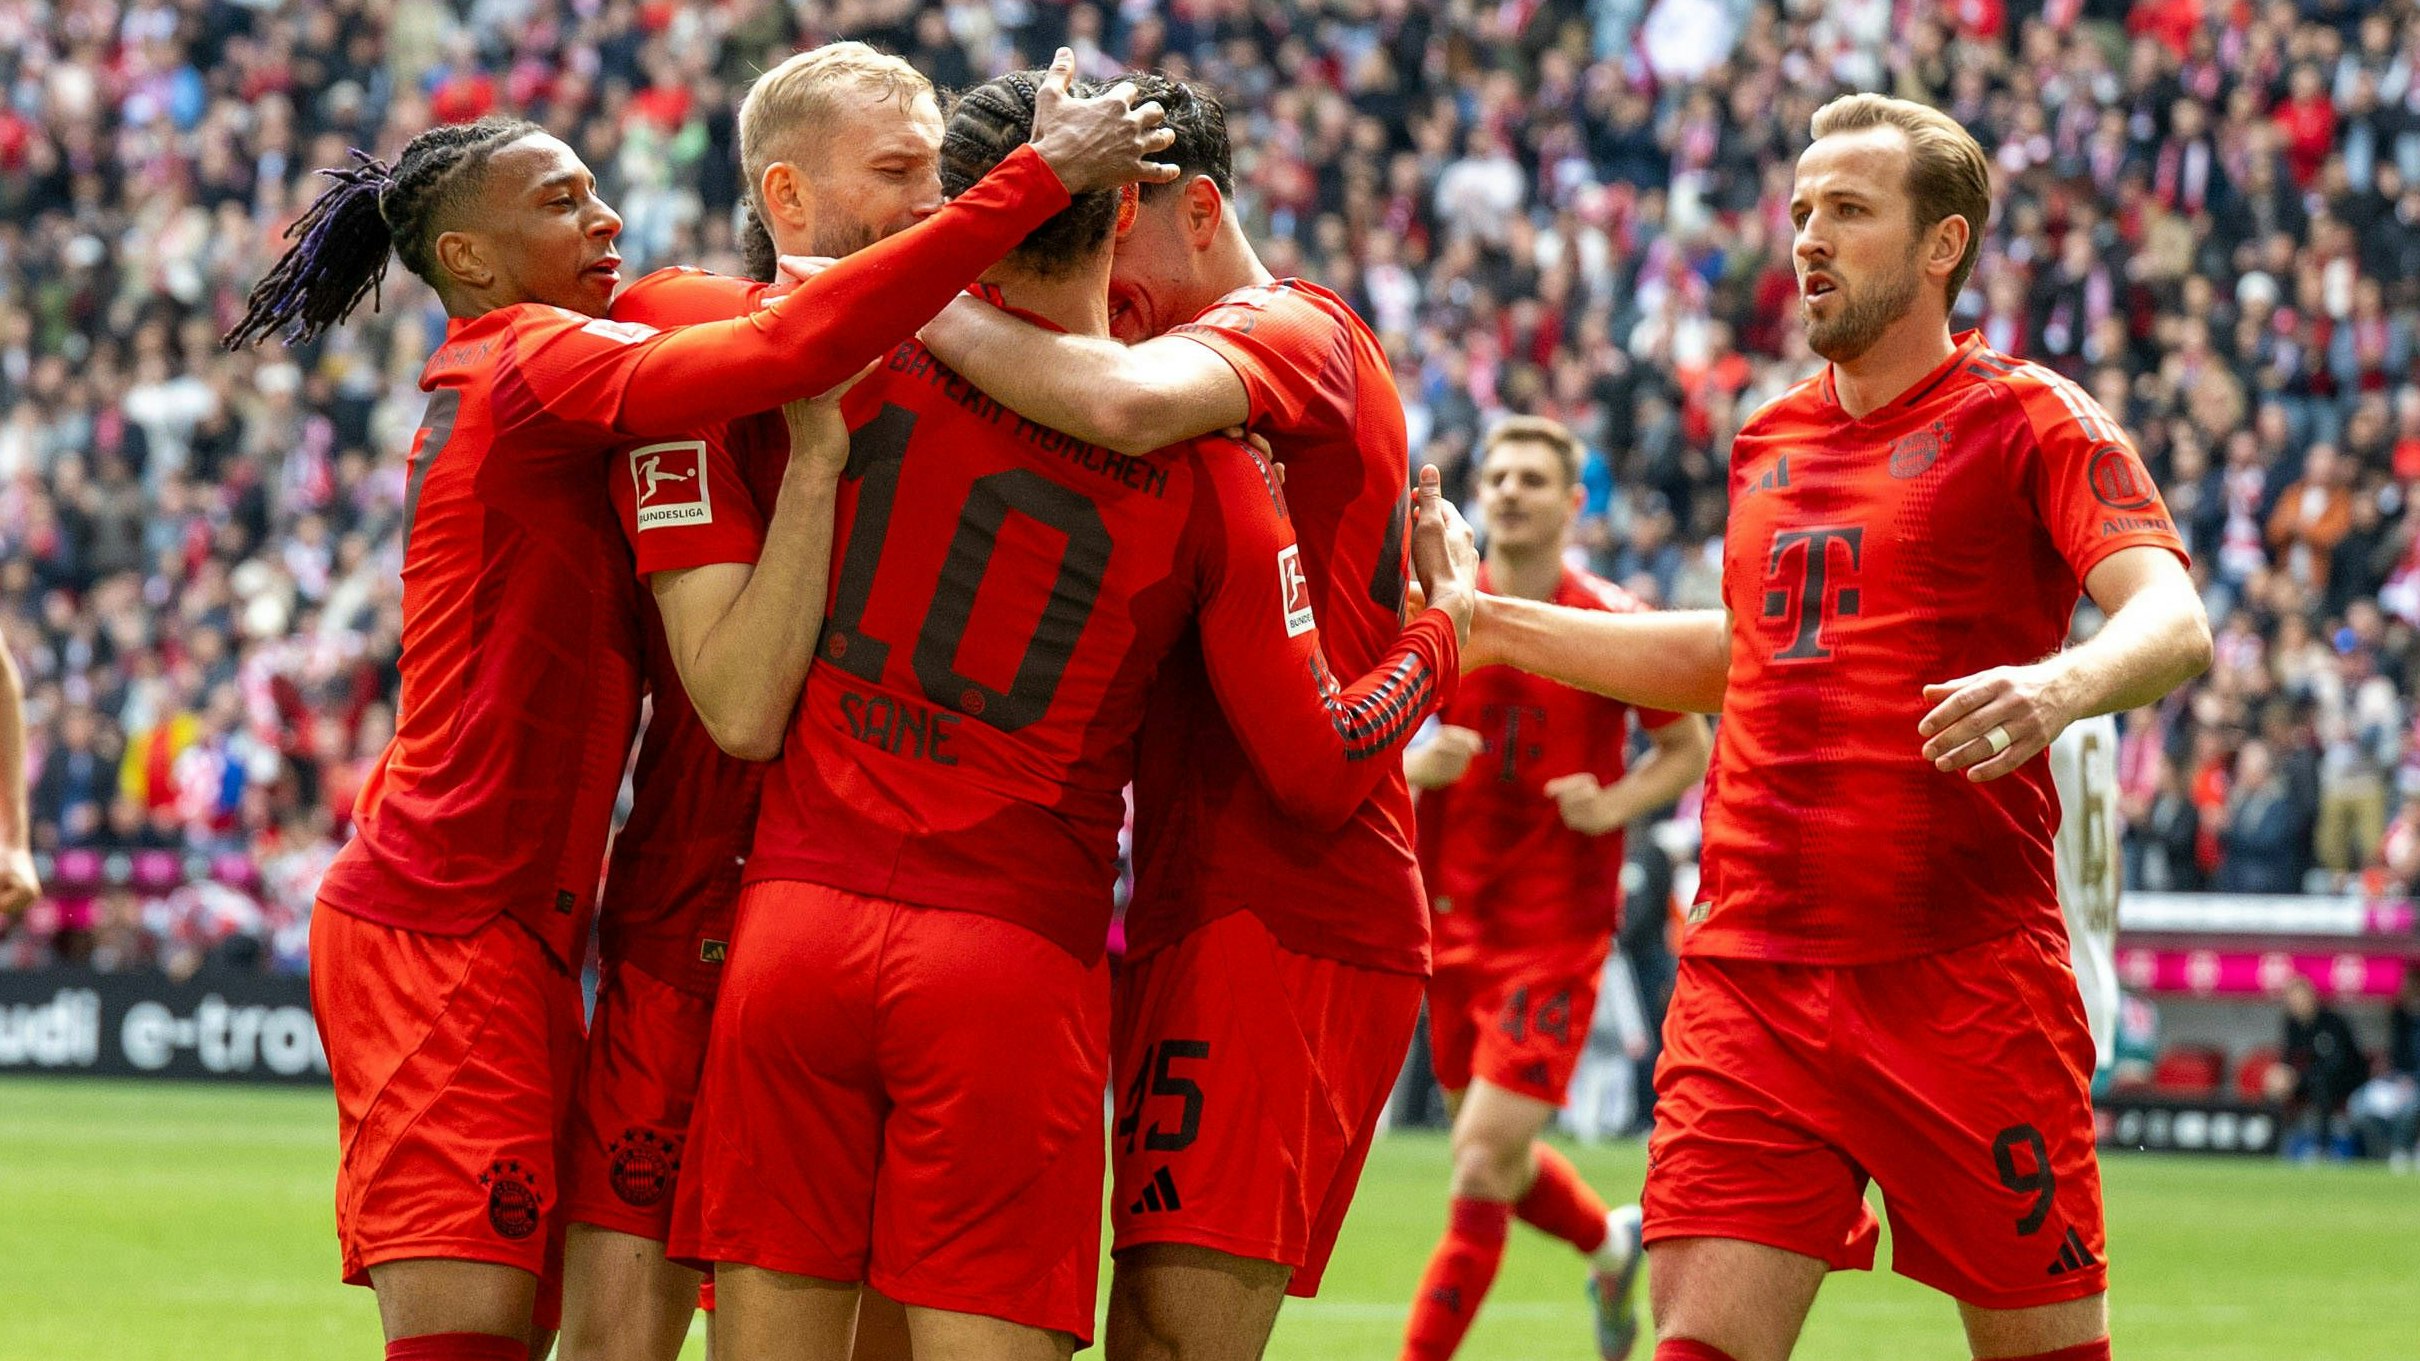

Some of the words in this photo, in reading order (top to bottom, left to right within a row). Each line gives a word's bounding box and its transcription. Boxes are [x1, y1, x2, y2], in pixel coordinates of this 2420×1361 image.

[813, 401, 1114, 733] 10
[1764, 527, 1863, 660] T
[839, 691, 961, 767] SANE
[1500, 985, 1570, 1044] 44
[1117, 1040, 1211, 1154] 45
[1992, 1123, 2055, 1236] 9
